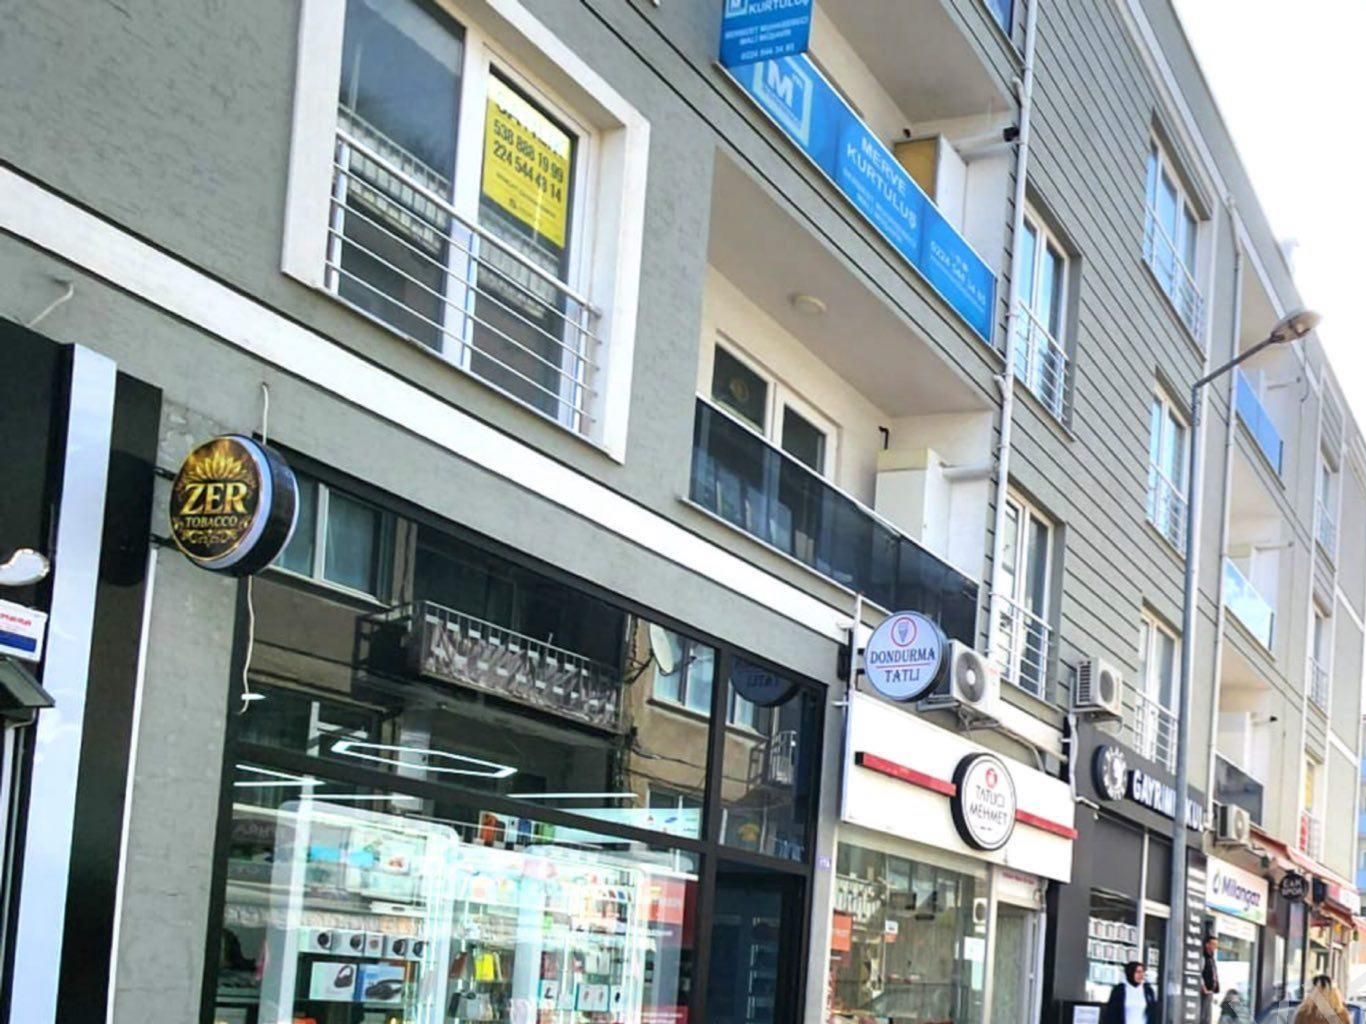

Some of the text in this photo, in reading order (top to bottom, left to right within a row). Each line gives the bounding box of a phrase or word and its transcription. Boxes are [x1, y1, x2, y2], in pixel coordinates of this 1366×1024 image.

[493, 140, 513, 166] 224
[514, 154, 534, 183] 544
[551, 182, 562, 203] 14
[861, 136, 906, 194] MERVE
[180, 482, 248, 515] ZER
[185, 515, 239, 527] TOBACCO
[870, 648, 936, 664] DONDURMA
[885, 668, 920, 682] TATLI
[969, 802, 1008, 825] MEHMET
[1222, 875, 1262, 911] Milangaz
